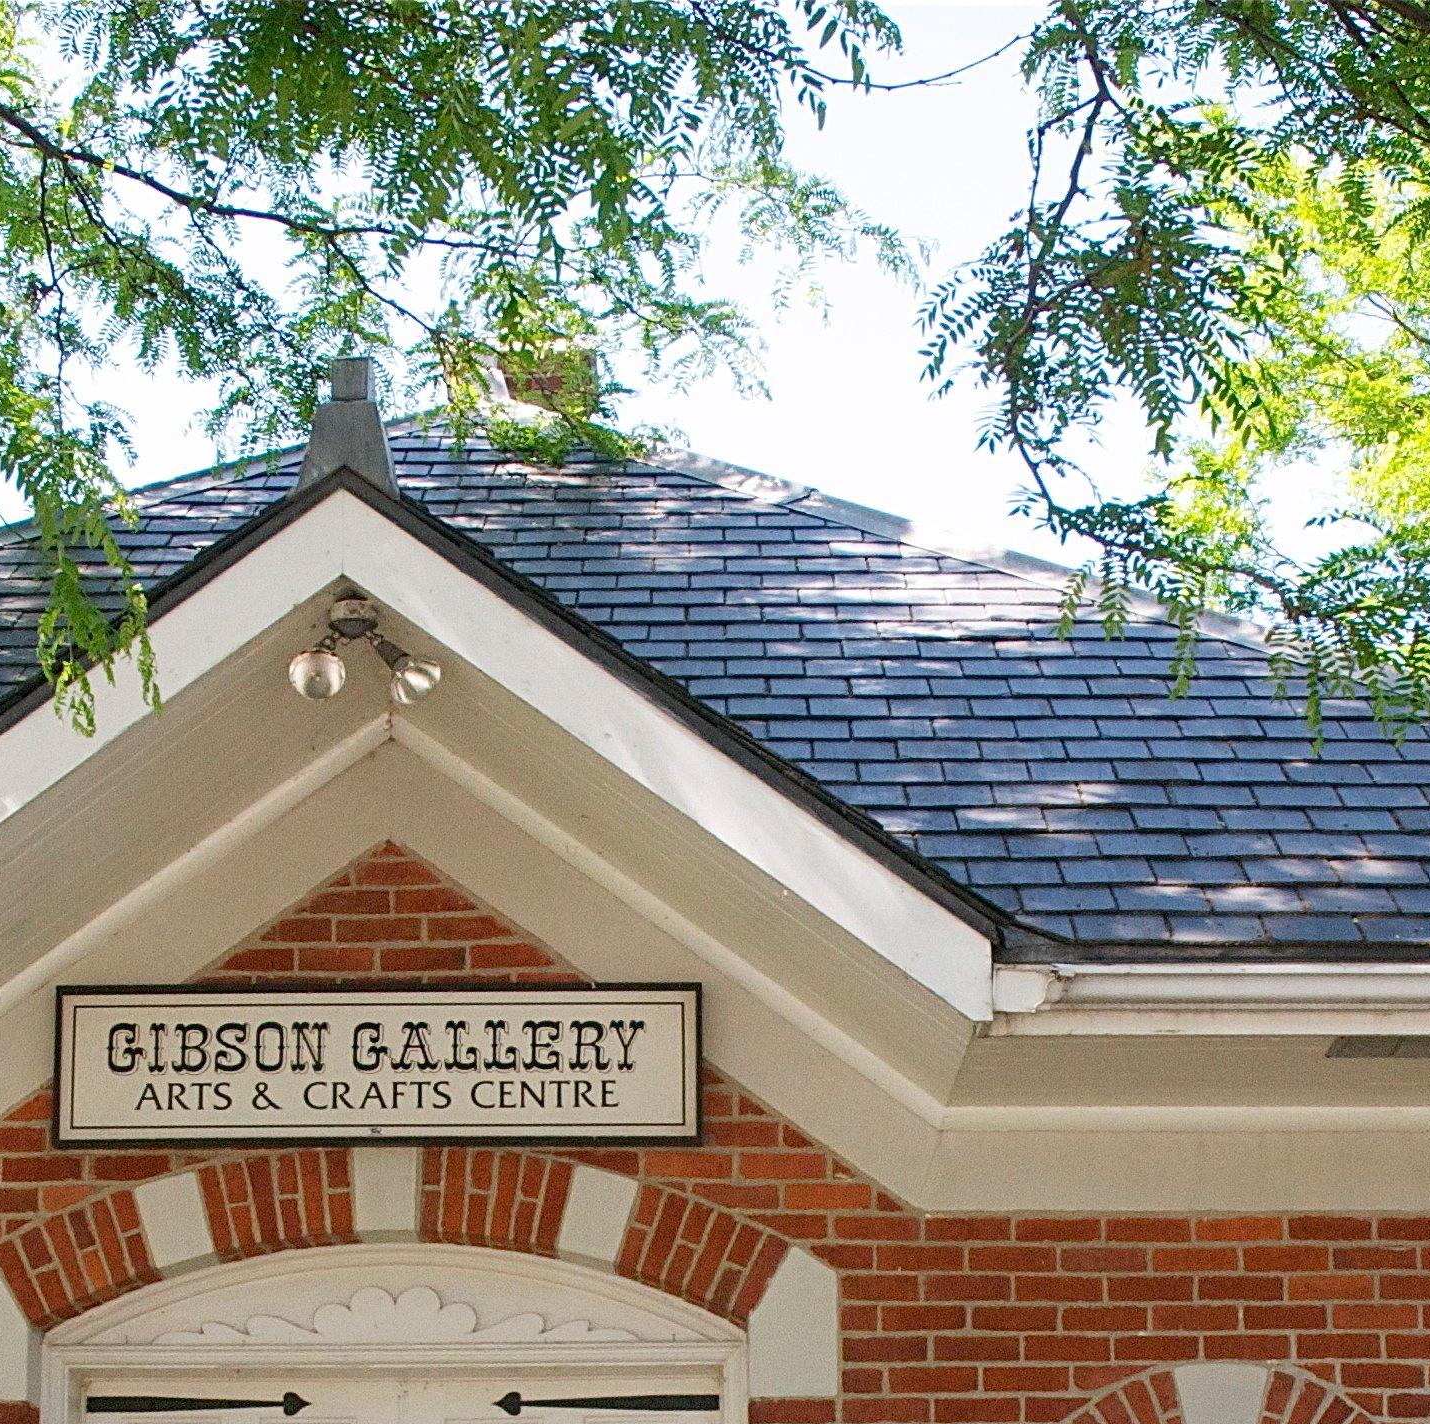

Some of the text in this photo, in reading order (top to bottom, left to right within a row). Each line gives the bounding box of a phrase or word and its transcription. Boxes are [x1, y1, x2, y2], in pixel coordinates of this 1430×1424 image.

[106, 1019, 646, 1075] GIBSON GALLERY
[134, 1079, 620, 1111] ARTS & CRAFTS CENTRE
